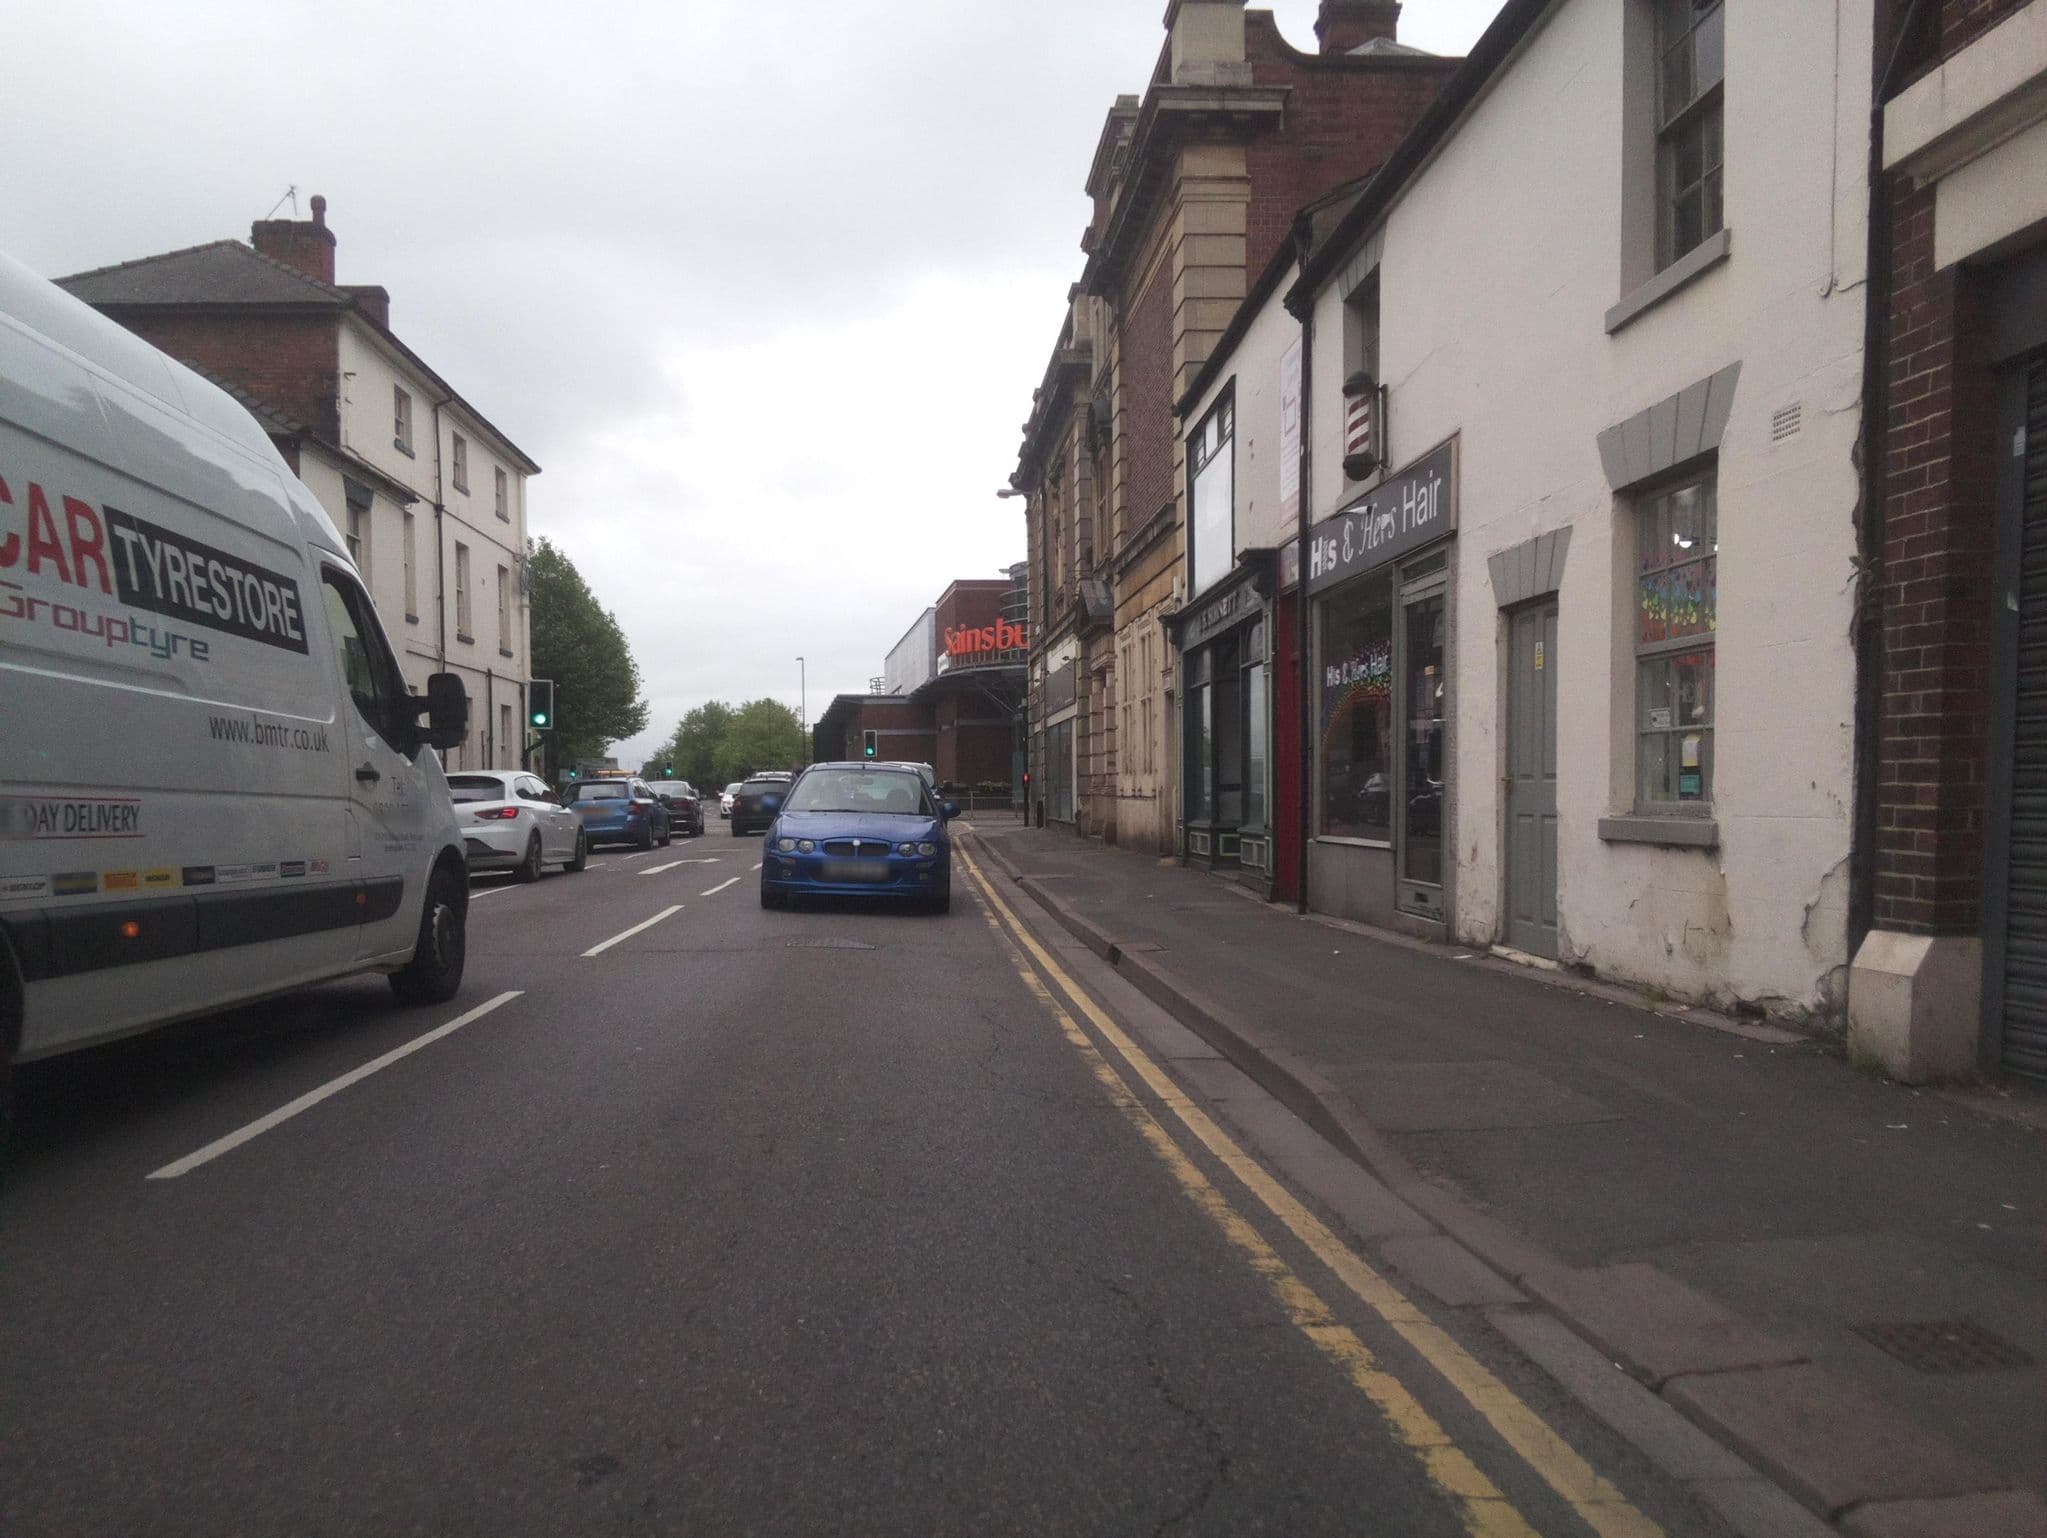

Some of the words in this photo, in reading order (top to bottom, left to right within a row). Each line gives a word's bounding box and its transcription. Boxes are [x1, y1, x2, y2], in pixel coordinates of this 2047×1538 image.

[1310, 535, 1337, 580] His
[1342, 518, 1354, 564] &
[1358, 502, 1397, 556] Hers
[1402, 470, 1441, 533] Hair
[113, 523, 302, 641] TYRESTORE
[209, 713, 330, 752] www.bmtr.co.uk
[64, 803, 140, 832] DELIVERY
